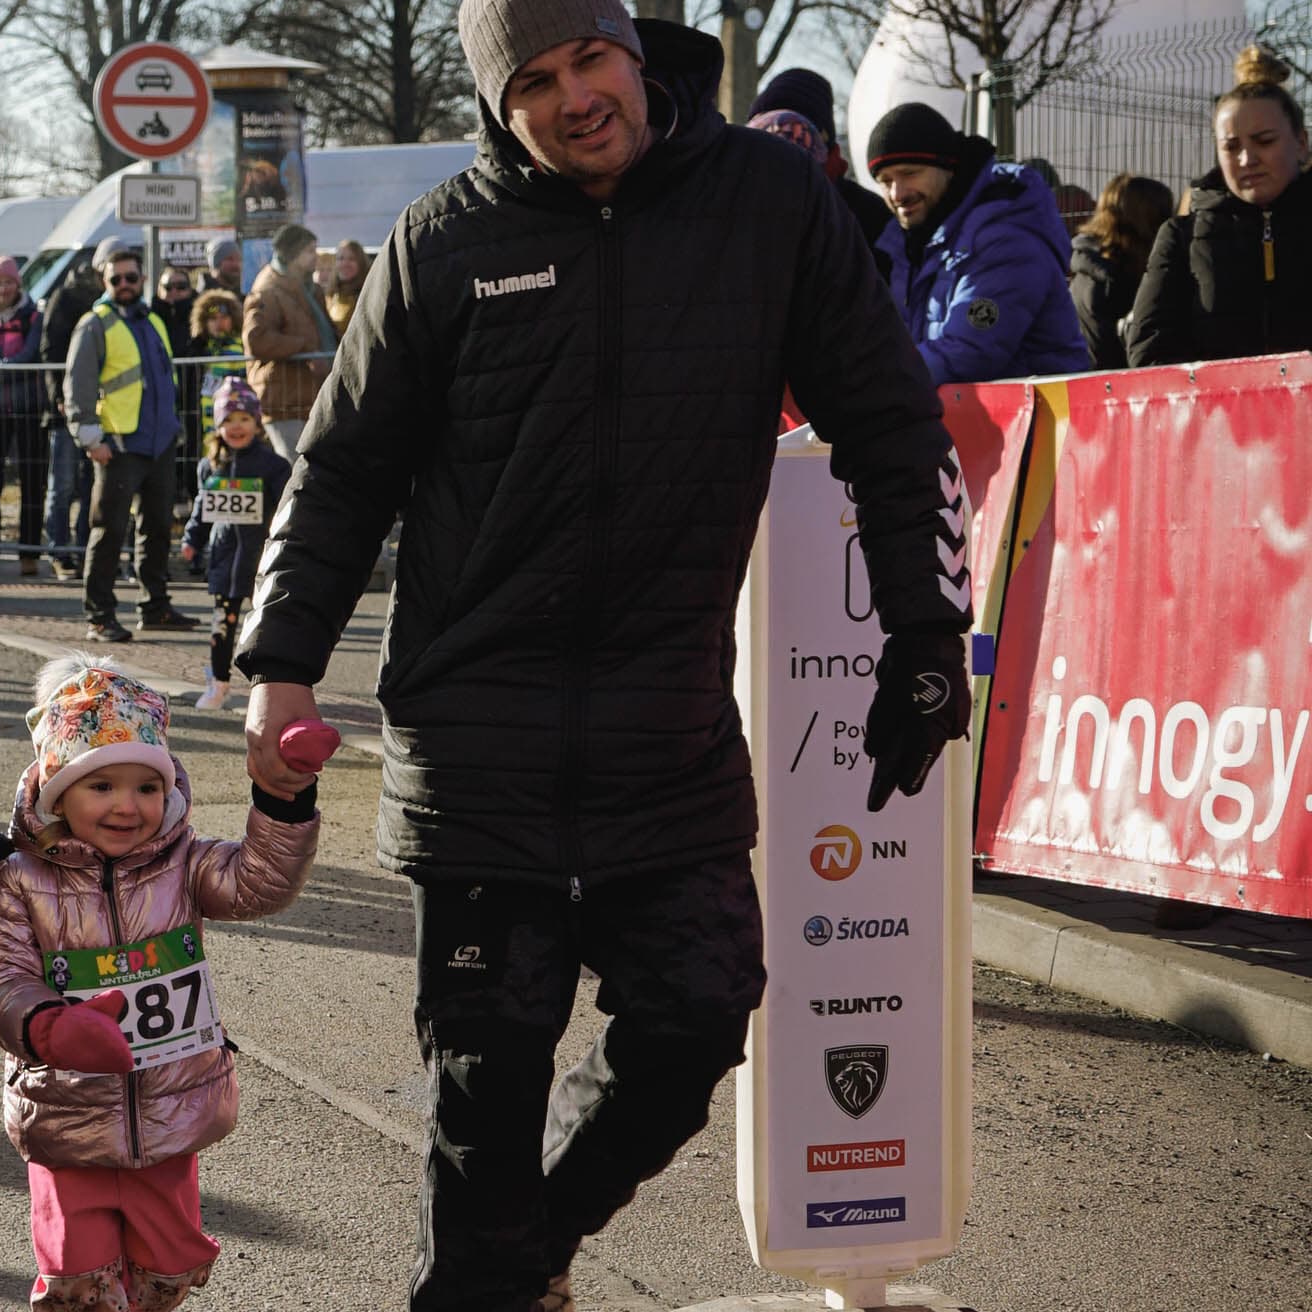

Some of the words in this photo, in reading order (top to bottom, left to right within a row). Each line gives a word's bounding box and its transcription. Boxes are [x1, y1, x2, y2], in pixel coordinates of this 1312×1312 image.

[474, 265, 556, 299] hummel
[206, 493, 256, 513] 3282
[791, 647, 876, 680] inno
[833, 746, 860, 770] by
[872, 840, 907, 859] NN
[836, 916, 909, 939] ŠKODA
[828, 995, 903, 1016] RUNTO
[831, 1050, 883, 1061] PEUGEOT
[813, 1145, 901, 1167] NUTREND
